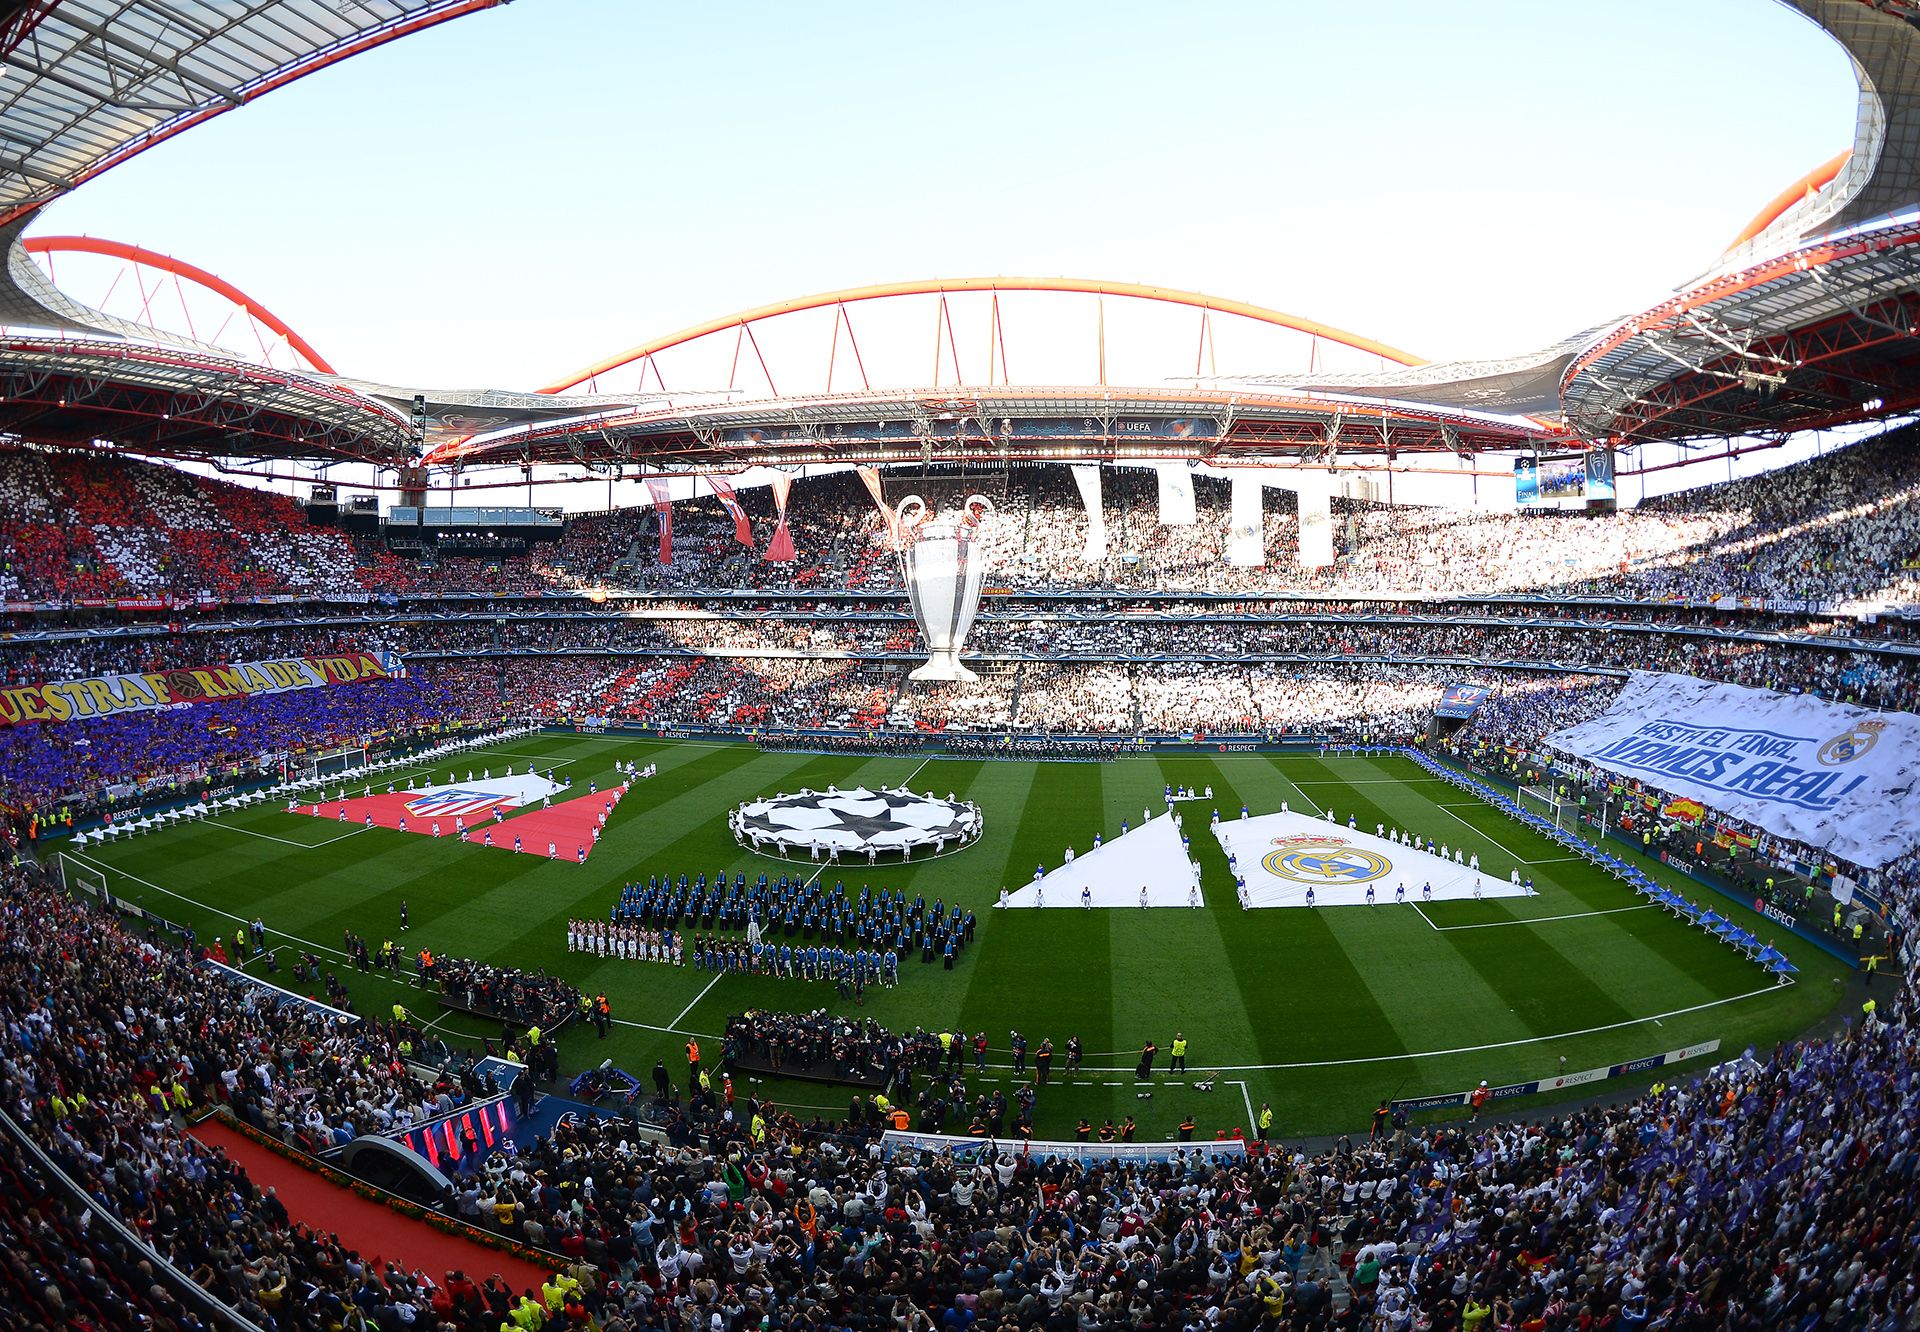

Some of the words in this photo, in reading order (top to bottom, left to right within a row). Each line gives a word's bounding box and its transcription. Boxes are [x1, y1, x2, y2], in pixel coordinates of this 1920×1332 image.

[1126, 423, 1151, 432] UEFA
[1764, 600, 1807, 611] VETERANOS
[262, 661, 312, 688] DE
[301, 656, 387, 683] VIDA
[582, 726, 605, 735] RESPECT
[665, 731, 690, 739] RESPECT
[1632, 721, 1708, 743] HASTA
[1697, 730, 1731, 748] EL
[1727, 733, 1799, 763] FINAL,
[1228, 744, 1257, 752] RESPECT
[372, 749, 392, 760] RESPECT
[296, 767, 315, 777] RESPEC
[1602, 736, 1747, 782] VAMOS
[1724, 761, 1869, 806] REAL!
[210, 785, 235, 798] RESPECT
[113, 807, 141, 821] RESPECT
[1667, 854, 1694, 875] RESPECT
[1764, 903, 1797, 928] RESPECT
[1686, 1045, 1710, 1056] RESPECT
[1628, 1059, 1655, 1071] RESPECT
[1564, 1073, 1593, 1085] RESPECT
[1494, 1086, 1525, 1097] RESPECT
[1419, 1098, 1442, 1108] LISBON
